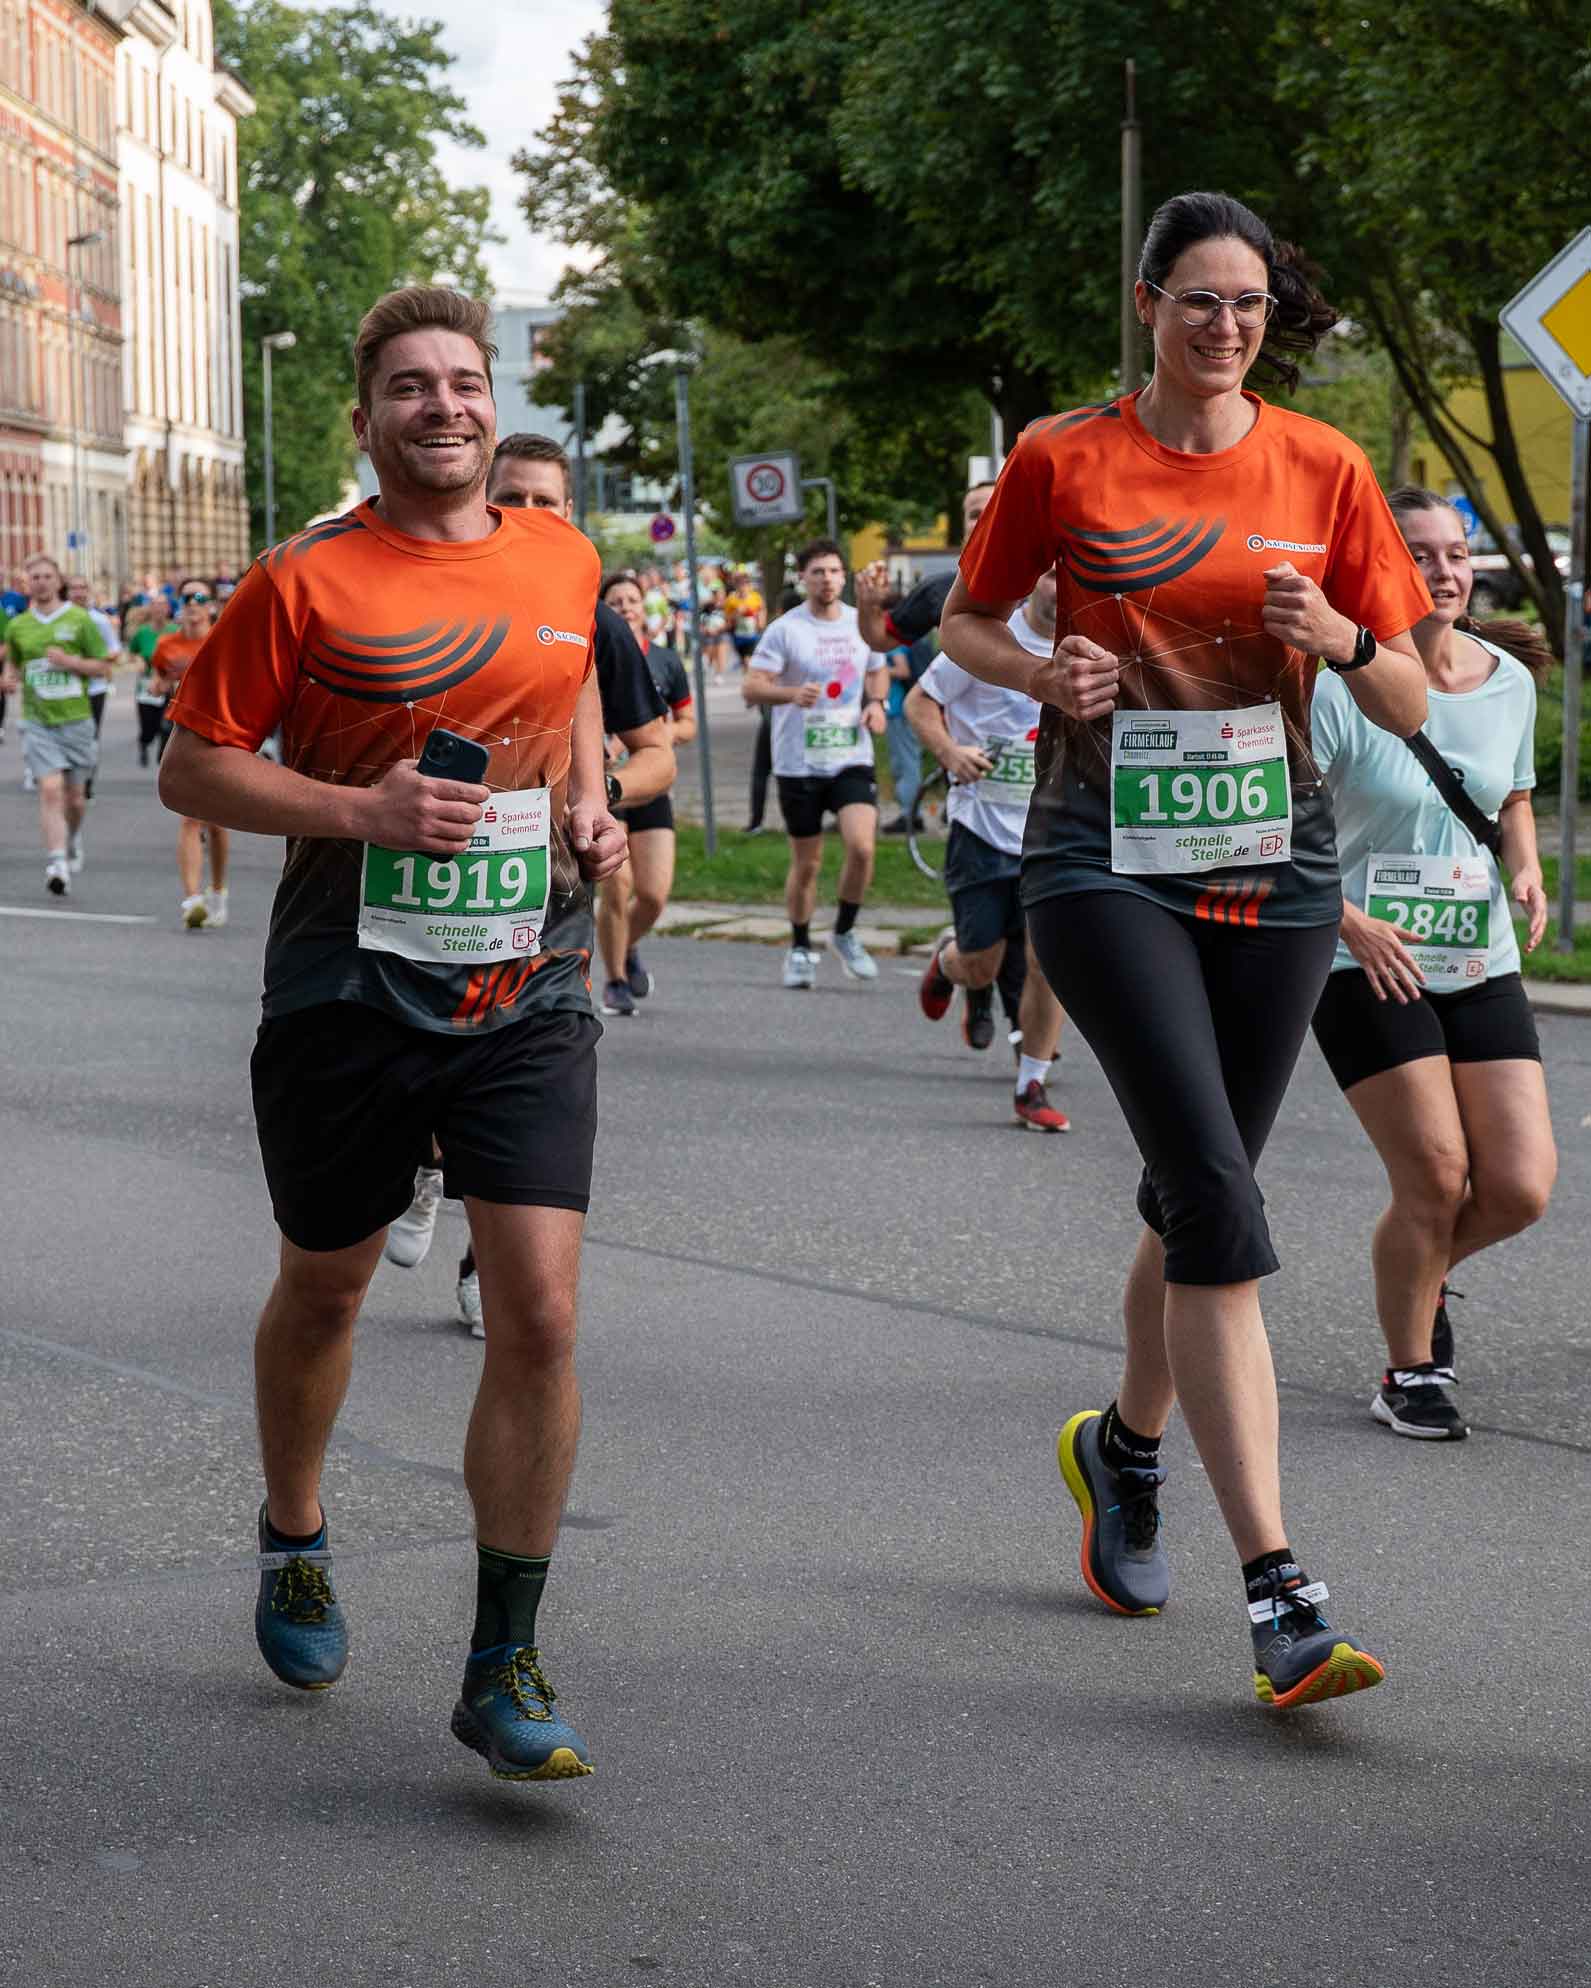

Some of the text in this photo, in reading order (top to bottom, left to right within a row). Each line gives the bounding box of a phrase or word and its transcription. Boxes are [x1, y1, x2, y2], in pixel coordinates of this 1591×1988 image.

[1236, 724, 1275, 738] Sparkasse
[1123, 733, 1176, 747] FIRMENLAUF
[1237, 736, 1275, 750] Chemnitz
[992, 755, 1035, 783] 255
[1138, 768, 1269, 821] 1906
[501, 810, 543, 824] Sparkasse
[501, 823, 541, 836] Chemnitz
[1175, 834, 1233, 848] schnelle
[1191, 846, 1250, 861] Stelle.de
[391, 856, 528, 909] 1919
[1386, 901, 1478, 943] 2848
[426, 923, 488, 937] schnelle
[442, 937, 503, 952] Stelle.de
[1413, 952, 1448, 962] chnelle
